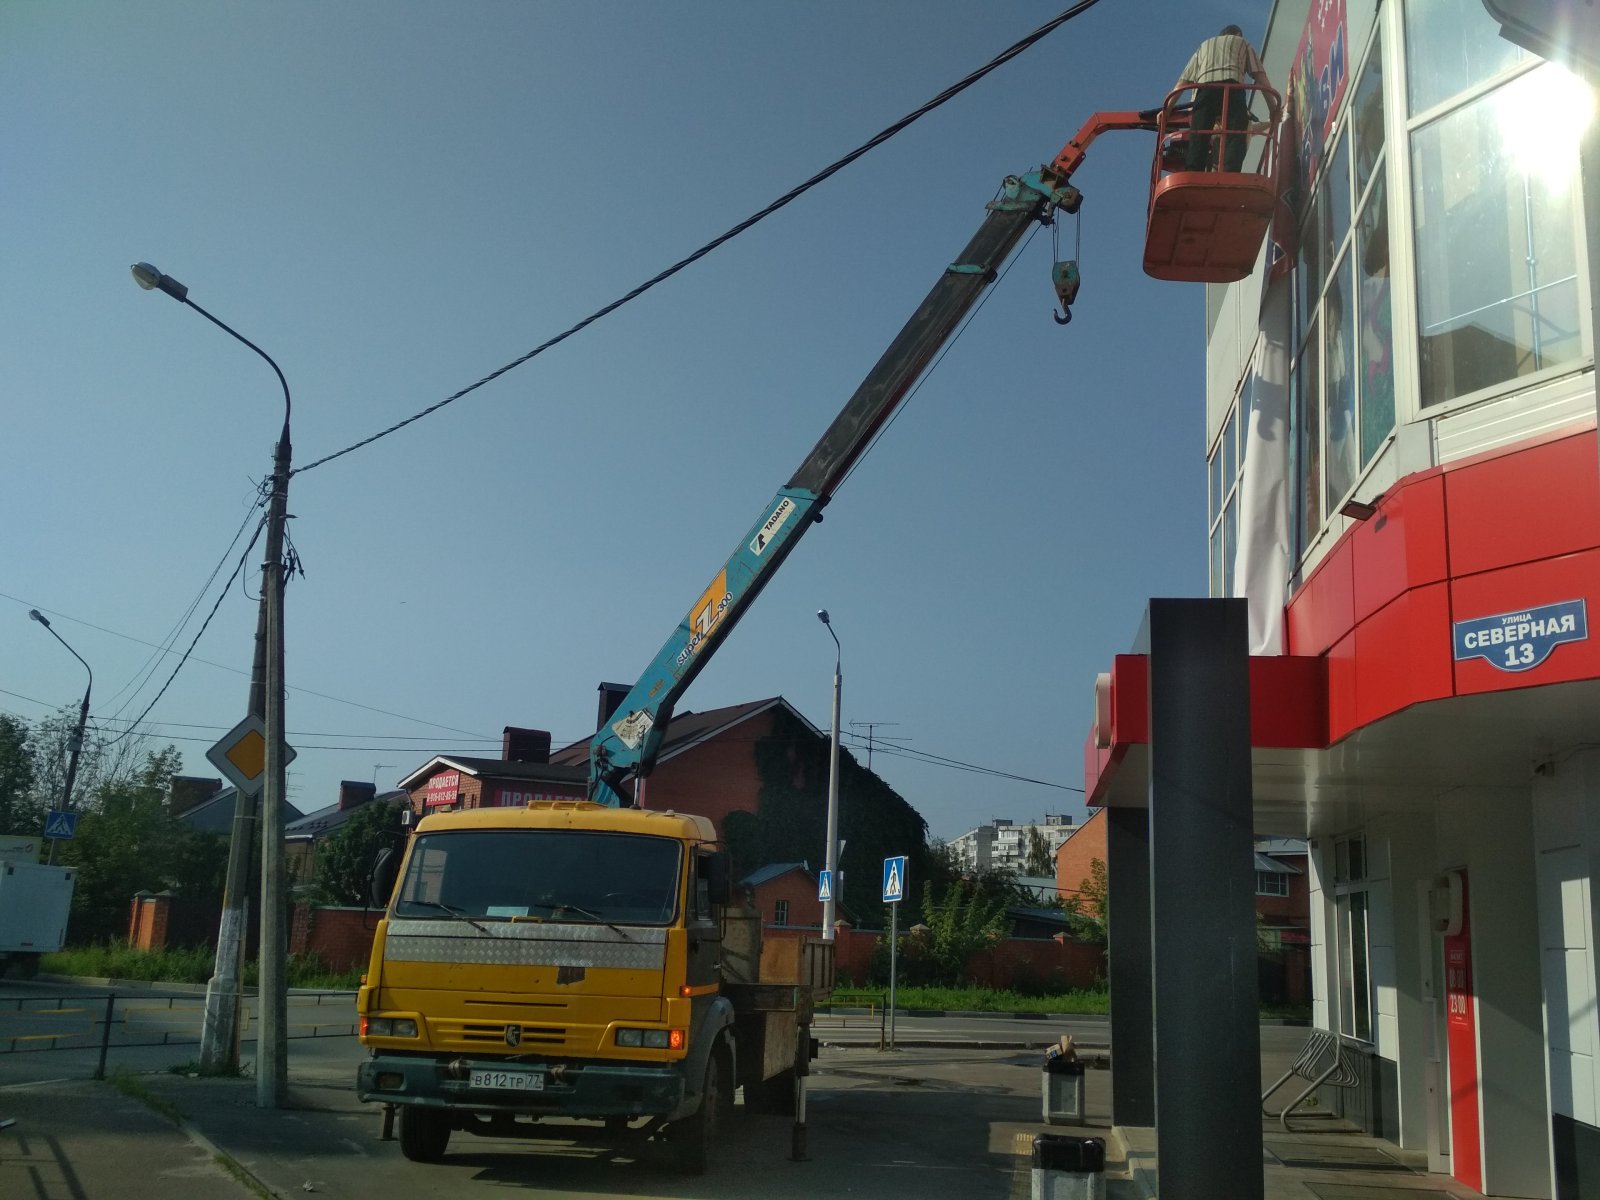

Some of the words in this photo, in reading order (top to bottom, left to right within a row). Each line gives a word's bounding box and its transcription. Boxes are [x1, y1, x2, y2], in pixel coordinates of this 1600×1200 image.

[764, 500, 789, 531] TADANO
[1464, 614, 1576, 649] СЕВЕРНАЯ
[1502, 613, 1532, 625] УЛИЦА
[677, 631, 703, 666] super
[1505, 643, 1535, 666] 13
[428, 774, 460, 790] ПРОДАЕТСЯ
